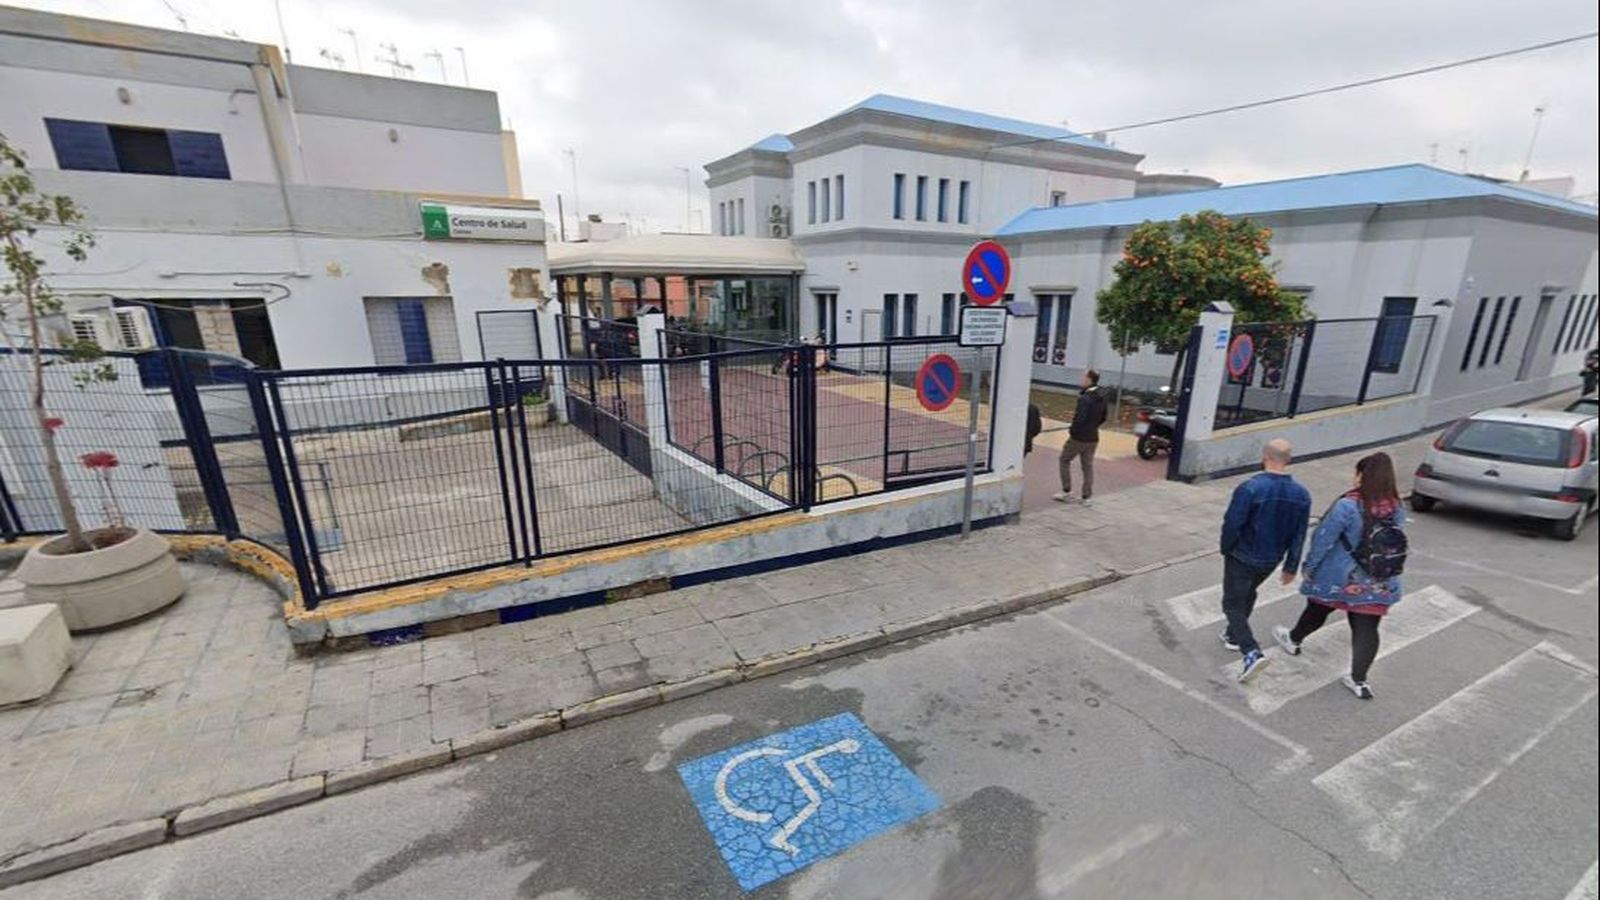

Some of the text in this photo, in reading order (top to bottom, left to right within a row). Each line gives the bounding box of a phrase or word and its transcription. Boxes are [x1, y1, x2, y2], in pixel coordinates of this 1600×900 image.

[452, 217, 527, 229] Centro de Salud
